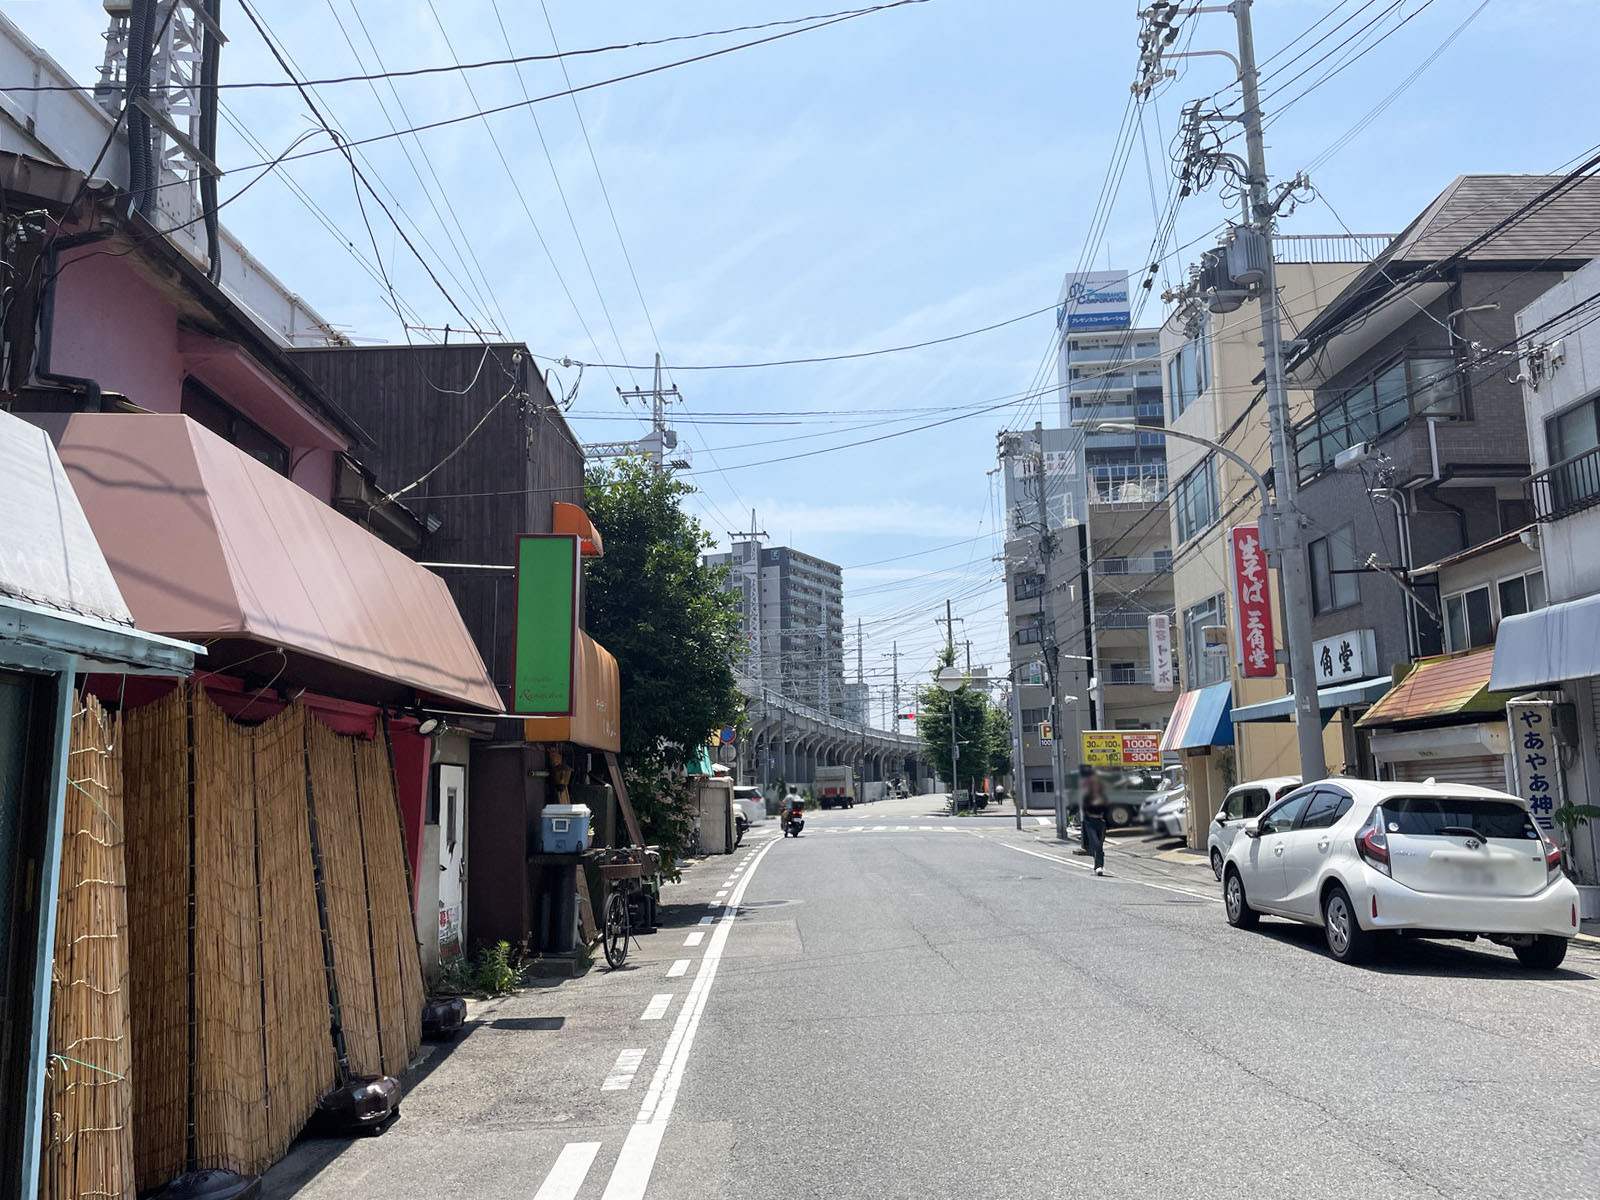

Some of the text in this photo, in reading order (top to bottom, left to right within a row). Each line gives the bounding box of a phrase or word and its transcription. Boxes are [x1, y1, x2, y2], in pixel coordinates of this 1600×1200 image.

[1238, 534, 1270, 669] 生そば 三角堂
[1043, 725, 1052, 738] P
[1520, 711, 1554, 829] やあやあ神戸
